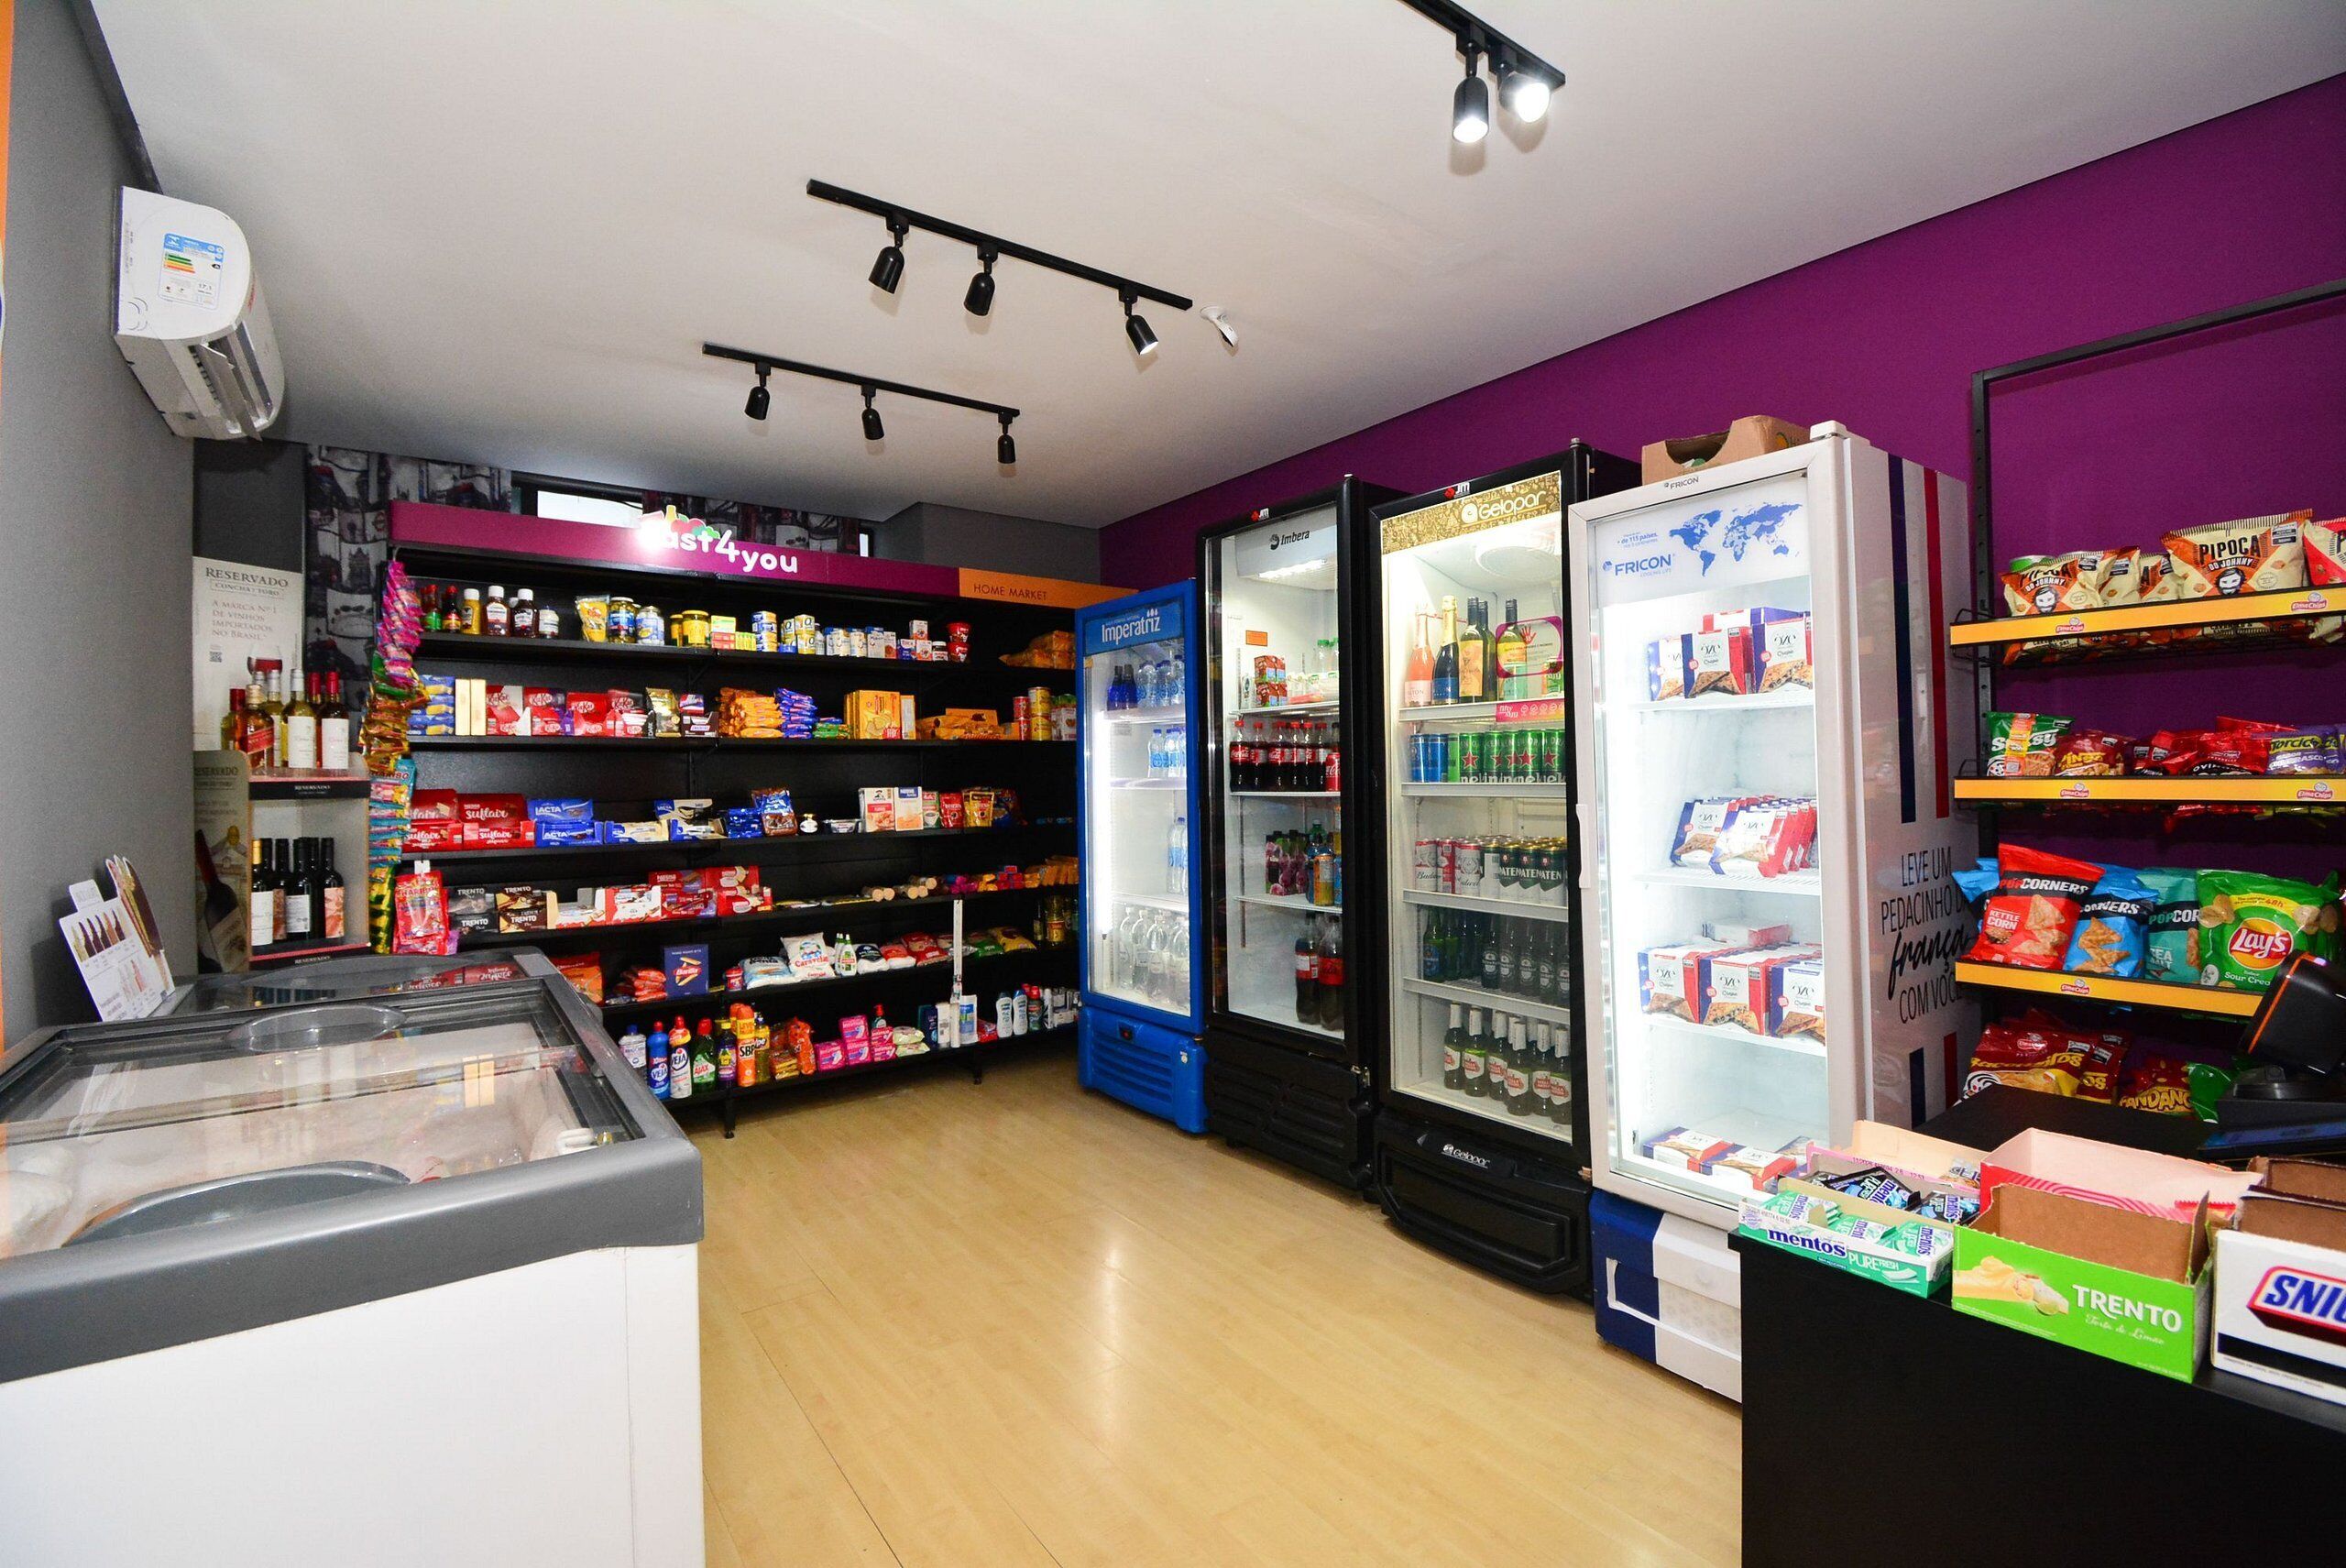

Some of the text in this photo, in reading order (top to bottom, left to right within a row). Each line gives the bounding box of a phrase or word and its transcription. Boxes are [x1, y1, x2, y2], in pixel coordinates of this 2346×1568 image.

[1670, 477, 1699, 489] FRICON
[1478, 490, 1547, 520] Gelopar
[1280, 529, 1310, 546] Imbera
[644, 529, 798, 574] ast4you
[2198, 534, 2261, 565] PIPOCA
[1615, 554, 1672, 576] FRICON
[2209, 556, 2253, 571] DO JOHNNY
[206, 567, 289, 587] RESERVADO
[973, 583, 1047, 601] HOME MARKET
[1102, 616, 1160, 645] Imperatriz
[531, 694, 552, 705] KitKat
[466, 807, 509, 821] suflair
[535, 806, 562, 816] LACTA
[479, 829, 512, 840] suflair
[1901, 846, 1952, 887] LEVE UM
[458, 888, 485, 897] TRENTO
[505, 886, 532, 894] TRENTO
[1880, 885, 1953, 935] PEDACINHO
[1989, 909, 2021, 922] KETTLE
[462, 917, 488, 927] TRENTO
[511, 915, 537, 924] TRENTO
[1987, 916, 2018, 930] CORN
[2231, 928, 2288, 959] Lay's
[1887, 923, 1968, 1001] frança
[2224, 971, 2246, 981] Sour
[1900, 983, 1930, 1024] COM
[652, 1068, 668, 1079] VEJA
[694, 1064, 709, 1074] AJAX
[1453, 1148, 1491, 1167] Gelopar
[1791, 1195, 1808, 1220] mentos
[1768, 1229, 1847, 1257] mentos
[1919, 1227, 1934, 1255] mentos
[1847, 1252, 1880, 1272] PURE
[1879, 1259, 1900, 1271] FRESH
[2071, 1284, 2182, 1332] TRENTO
